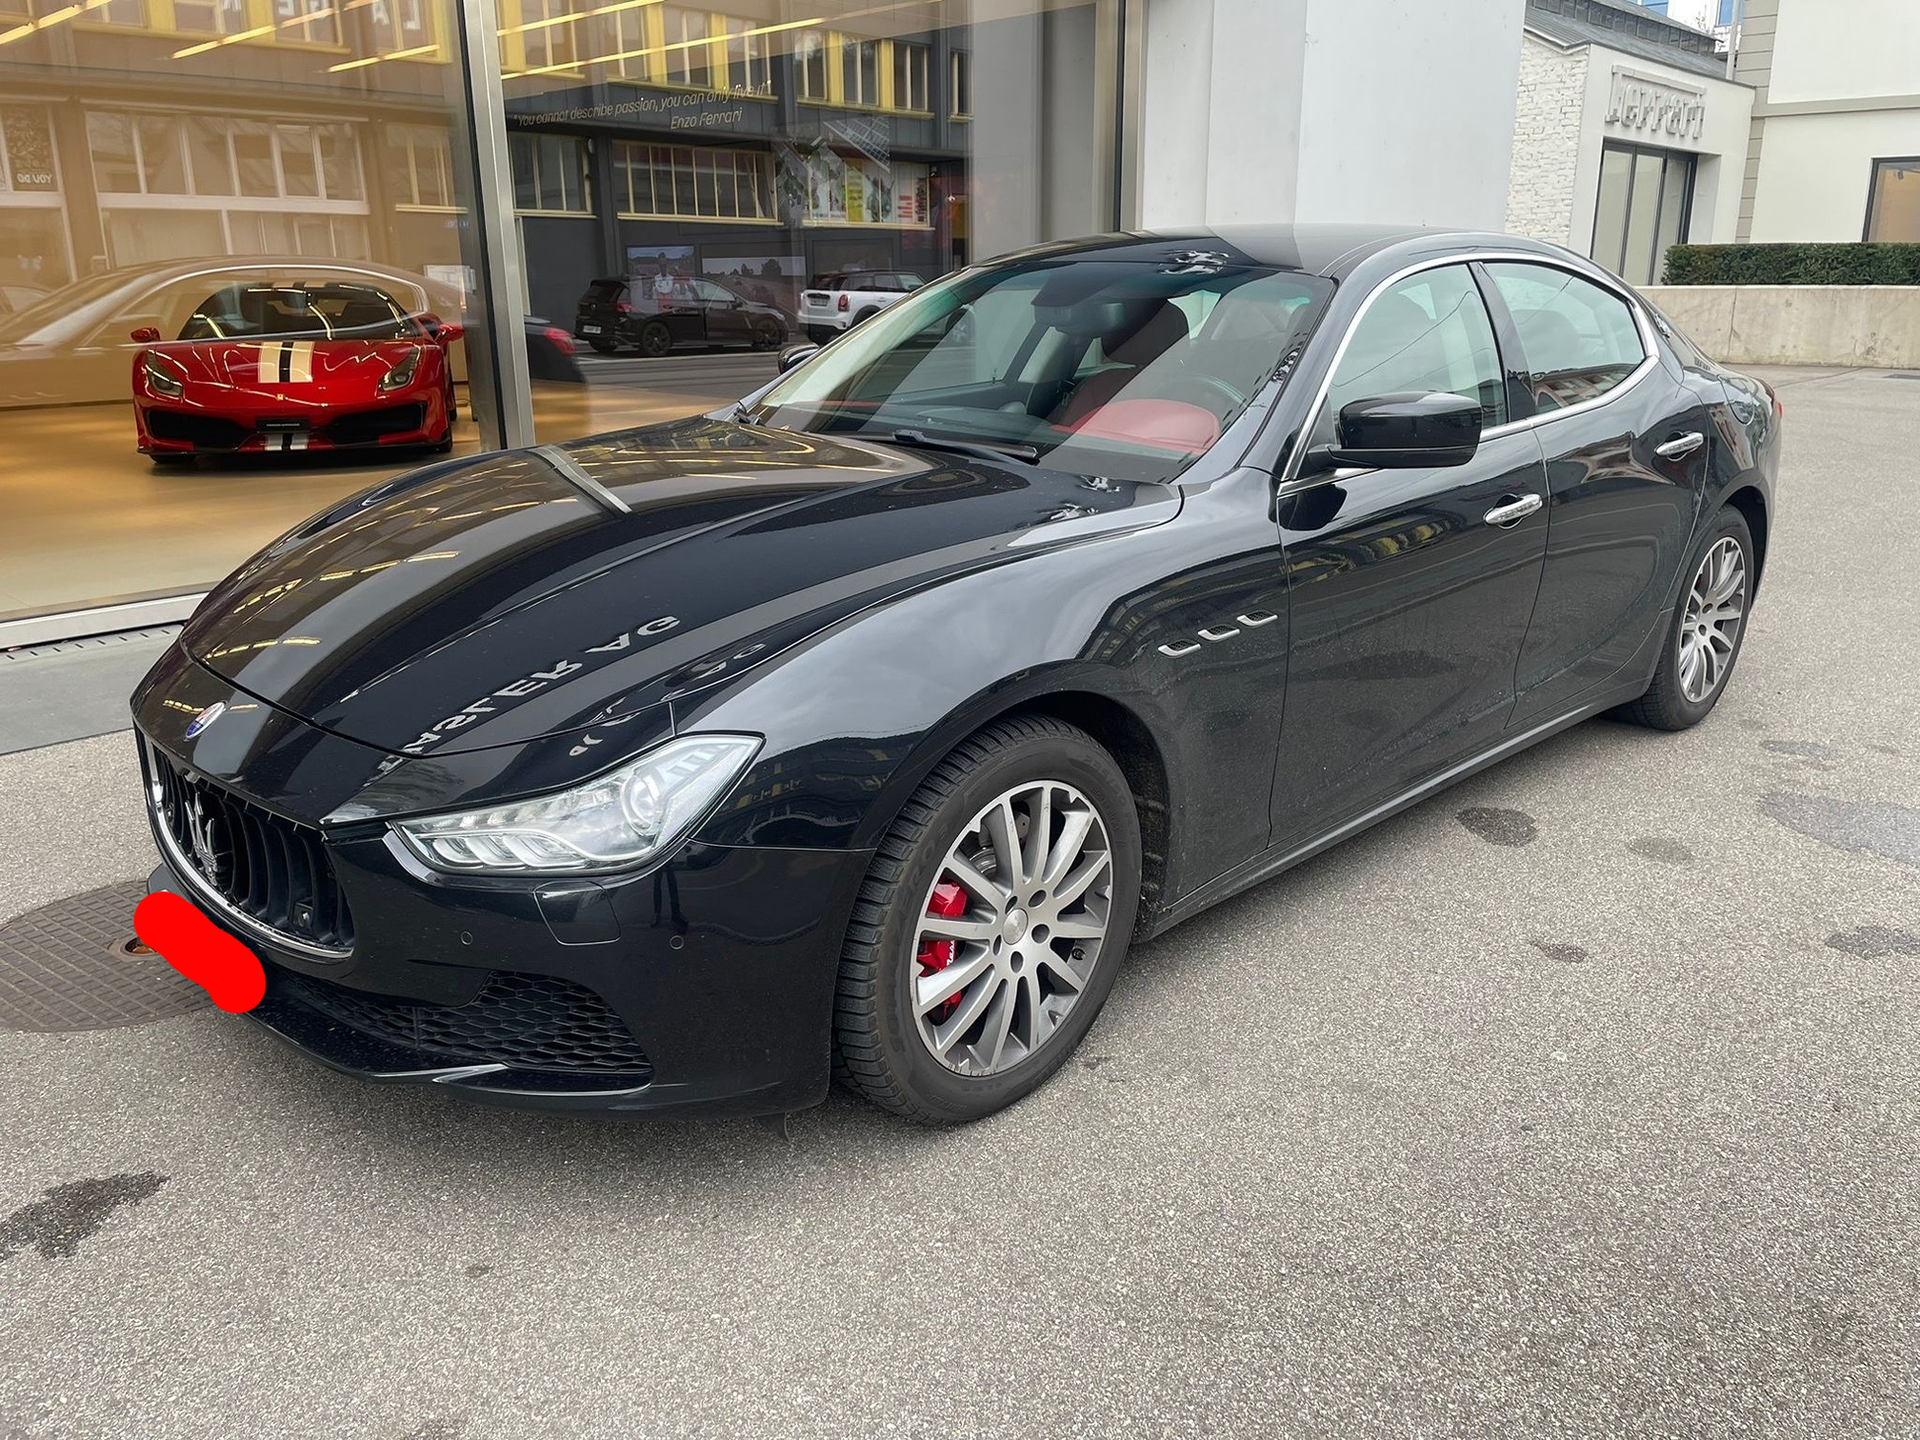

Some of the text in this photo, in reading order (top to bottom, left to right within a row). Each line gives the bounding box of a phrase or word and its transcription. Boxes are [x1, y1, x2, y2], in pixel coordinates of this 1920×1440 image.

[536, 109, 569, 124] cannot
[570, 102, 613, 119] describe
[615, 98, 659, 117] passion,
[660, 96, 681, 112] you
[683, 93, 705, 106] can
[707, 86, 731, 104] only
[670, 107, 743, 129] Enzo Ferrari
[1605, 65, 1707, 139] Ferrari
